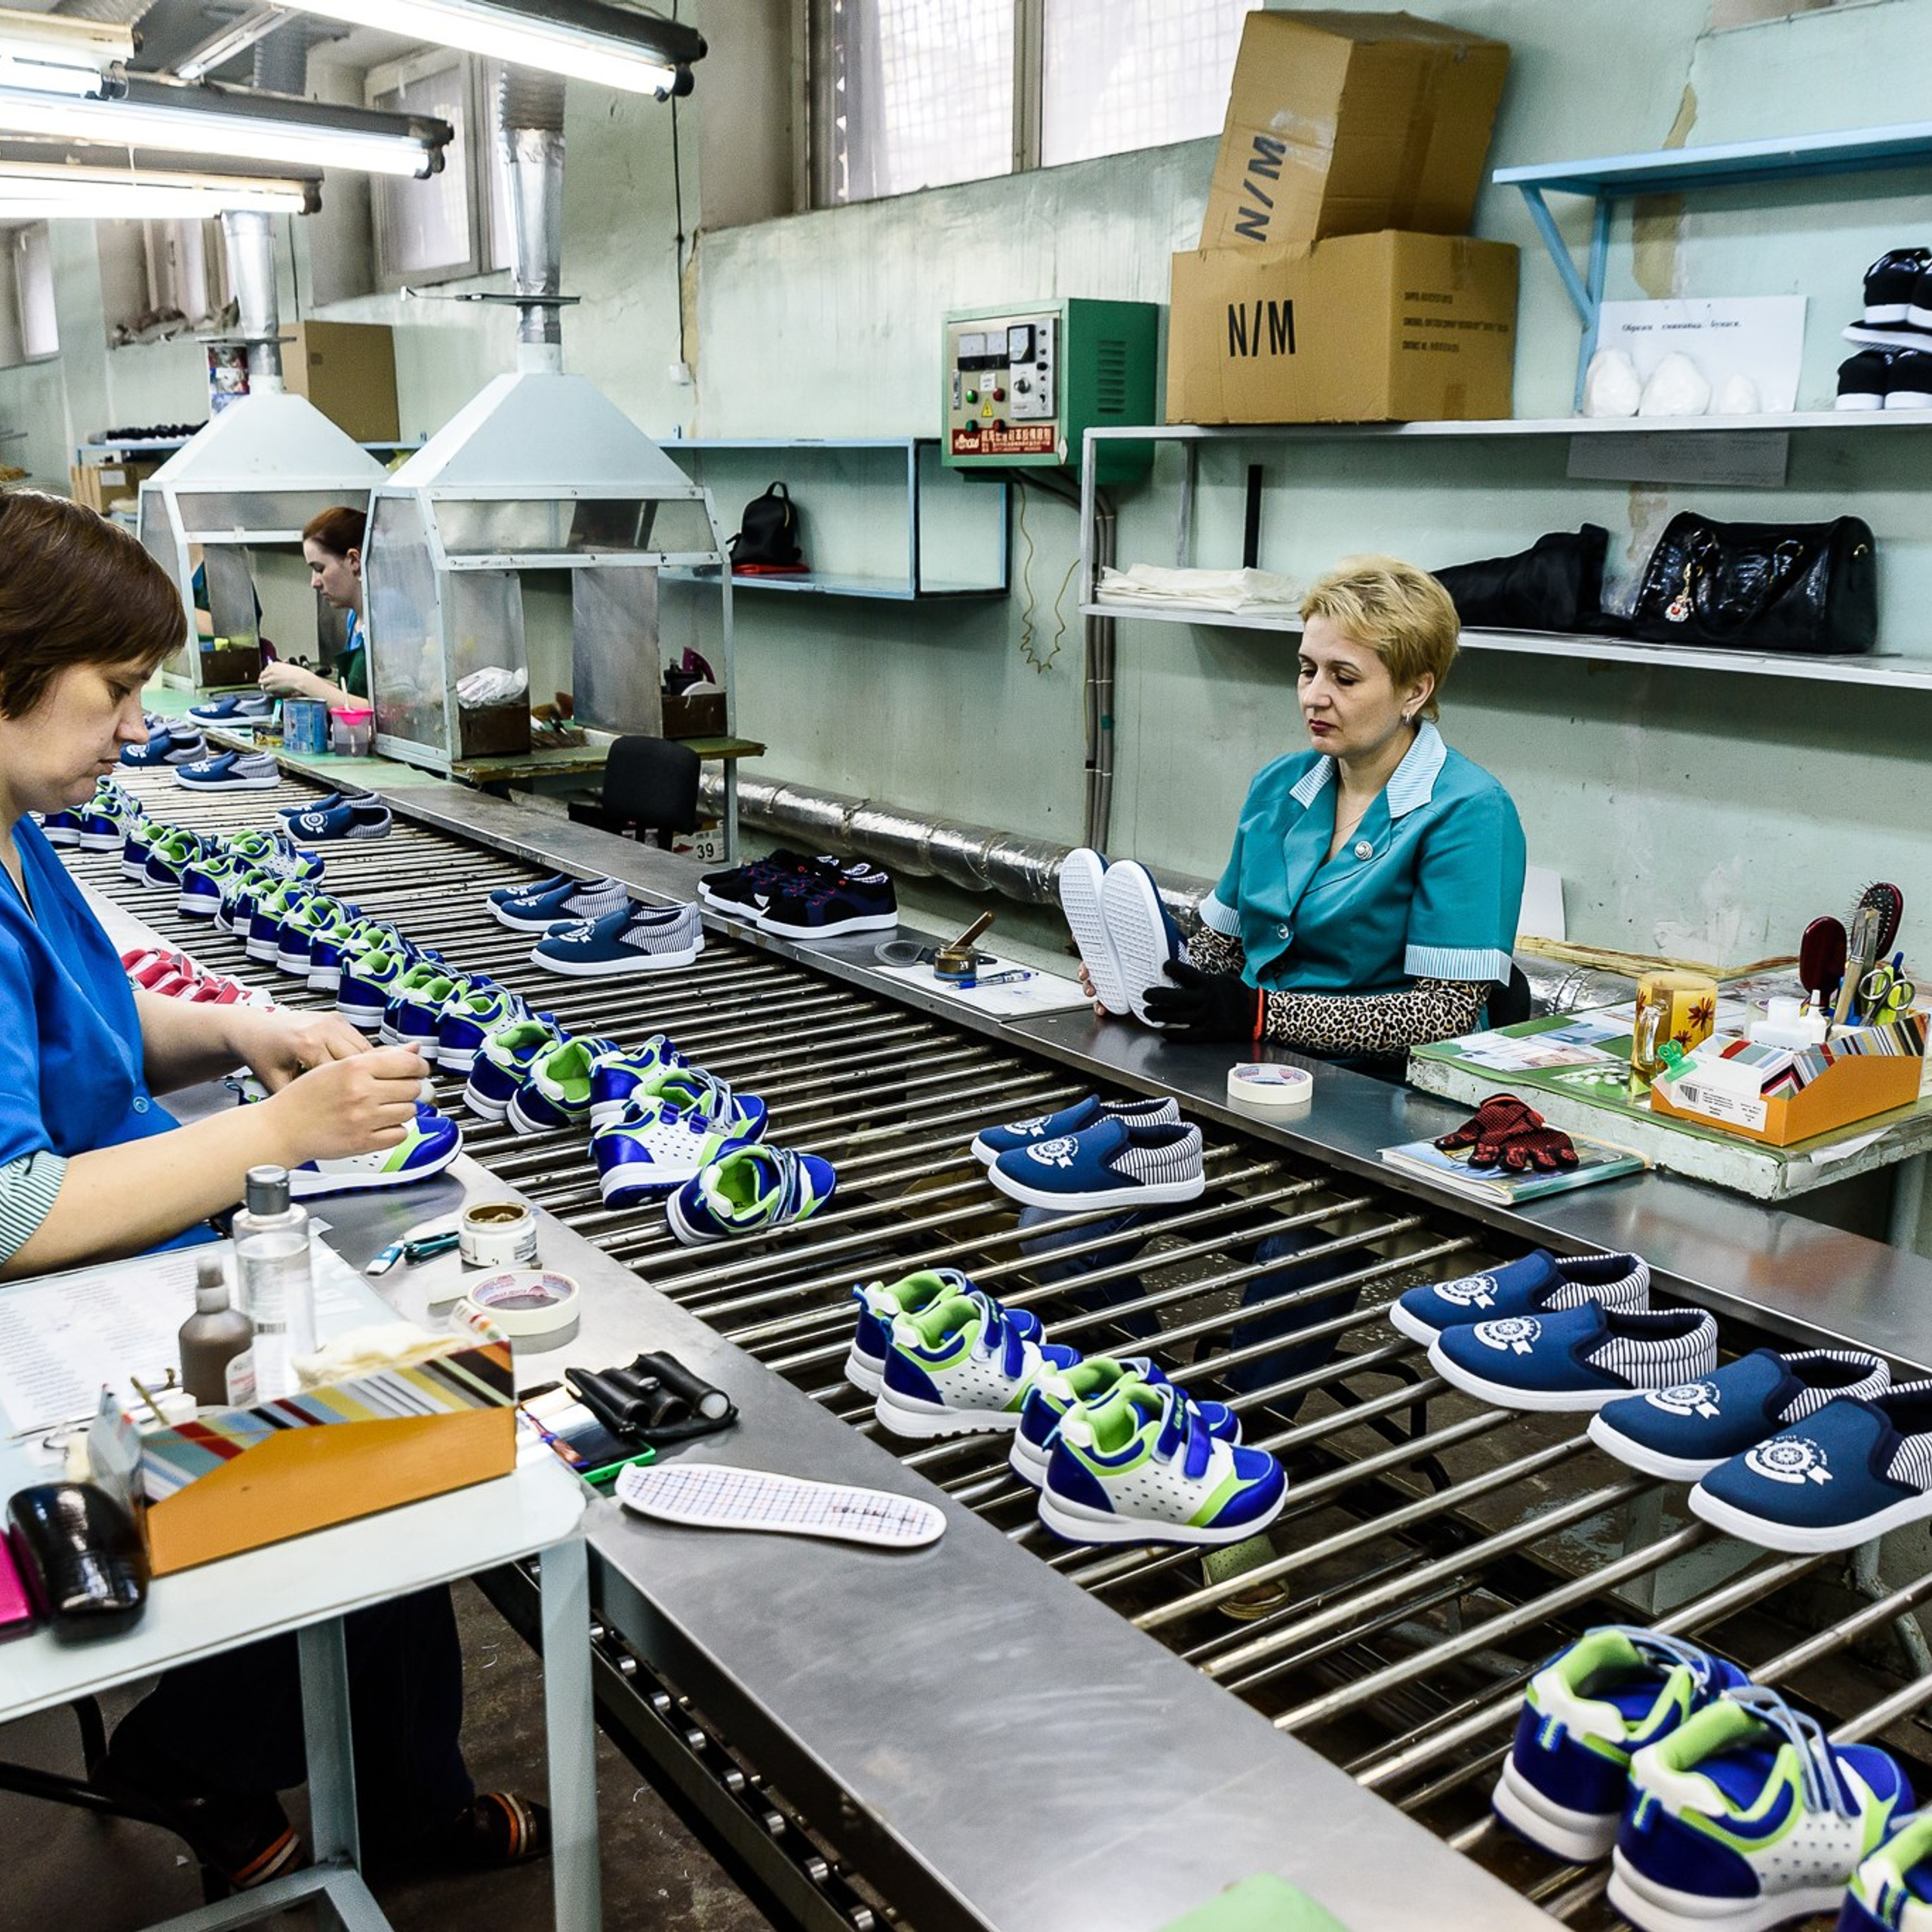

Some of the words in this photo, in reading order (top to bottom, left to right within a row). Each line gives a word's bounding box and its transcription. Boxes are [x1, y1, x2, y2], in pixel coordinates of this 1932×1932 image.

[1235, 136, 1286, 242] N/M
[1228, 300, 1296, 357] N/M
[697, 842, 714, 859] 39
